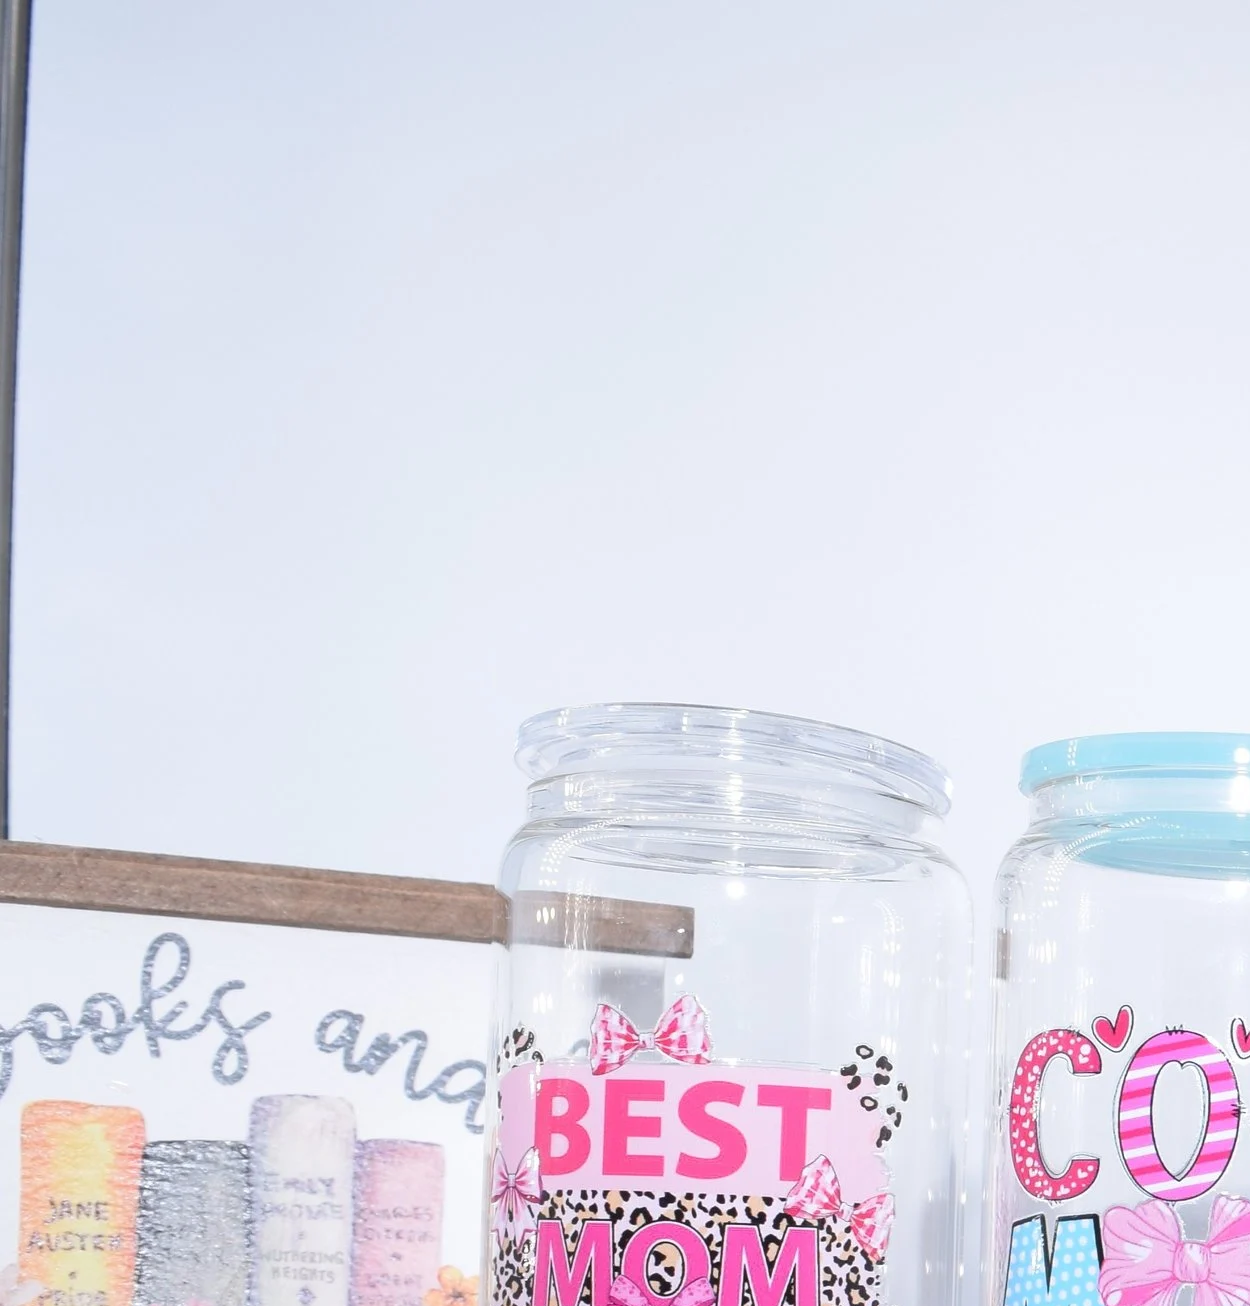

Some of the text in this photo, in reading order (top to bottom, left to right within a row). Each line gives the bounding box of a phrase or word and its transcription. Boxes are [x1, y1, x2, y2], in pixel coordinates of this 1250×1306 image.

[0, 932, 271, 1100] ooks
[534, 1077, 832, 1182] BEST
[43, 1197, 109, 1225] JANE
